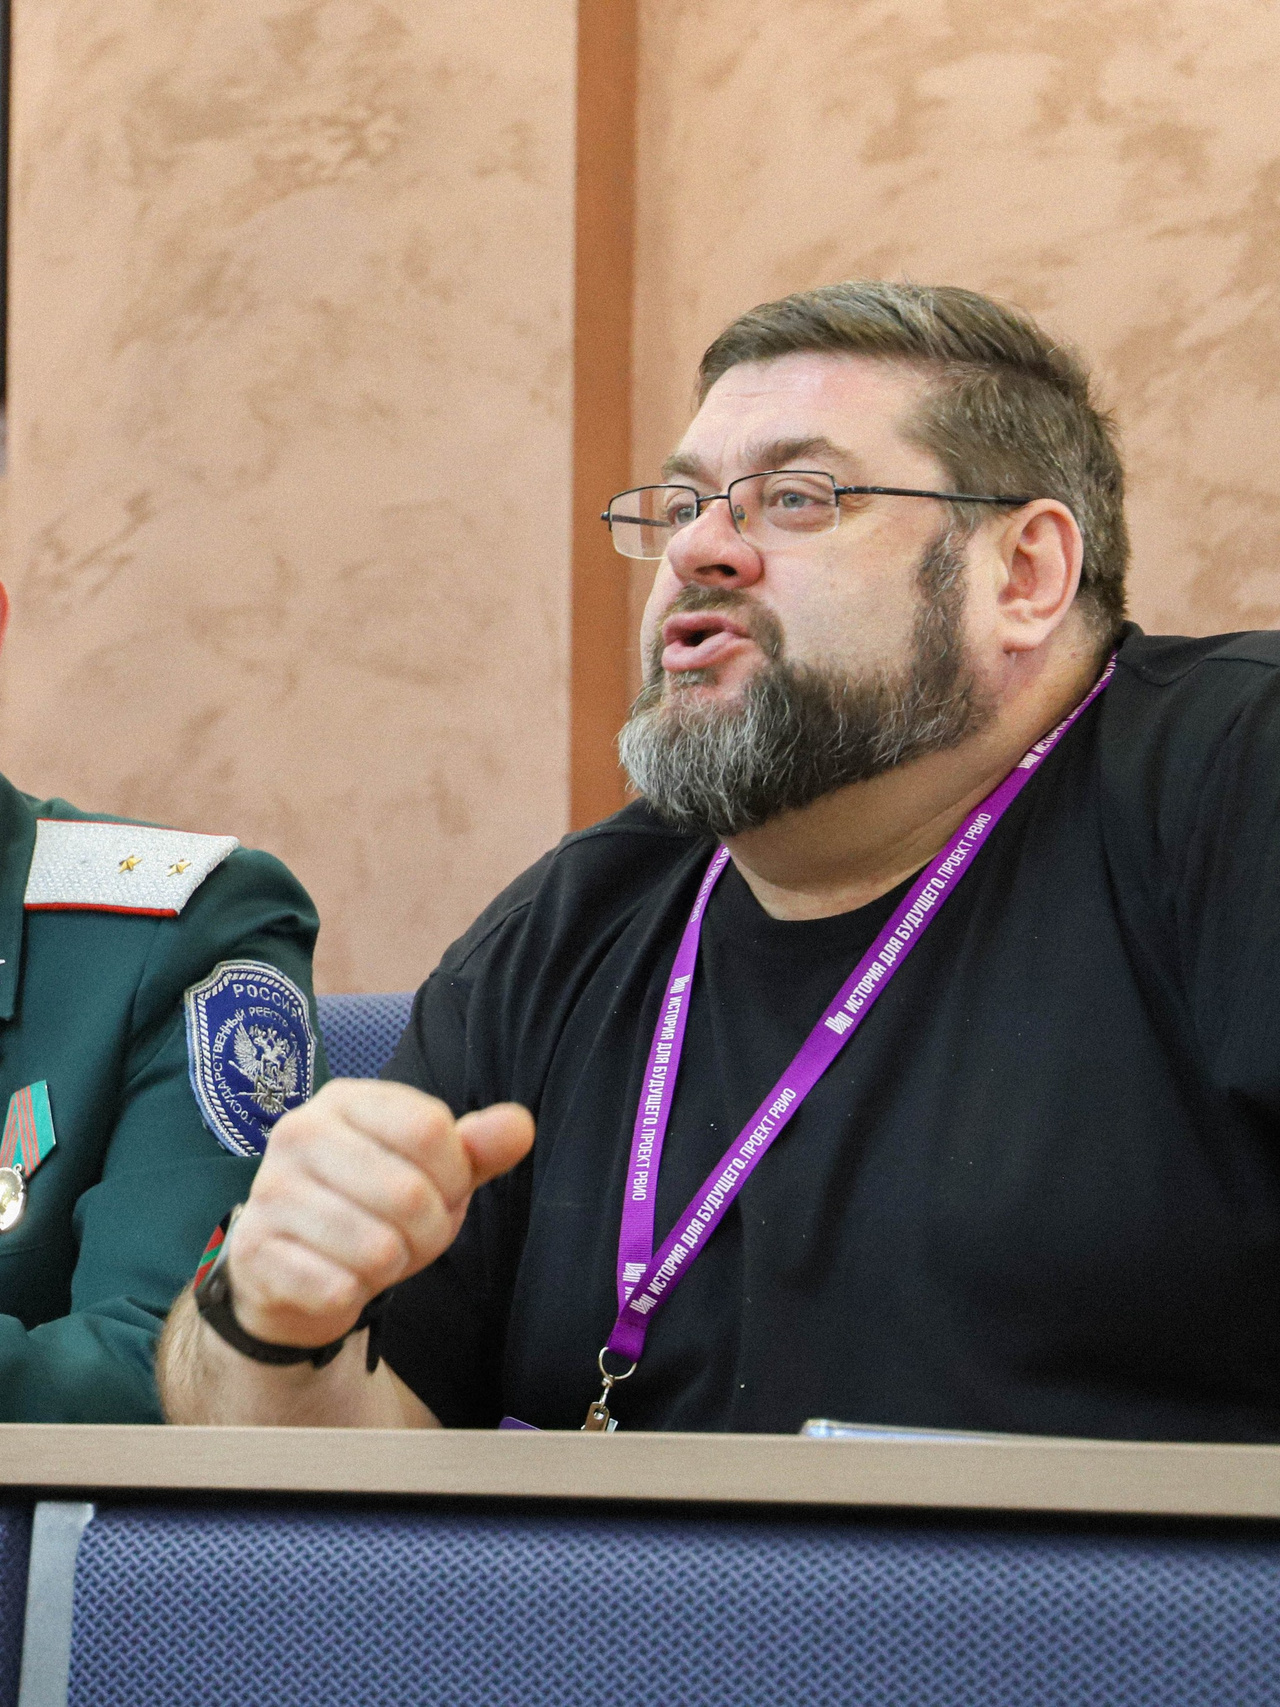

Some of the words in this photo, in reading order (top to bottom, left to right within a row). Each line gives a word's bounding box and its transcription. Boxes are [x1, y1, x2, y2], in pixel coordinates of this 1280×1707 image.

[844, 961, 886, 1014] ИСТОРИЯ
[878, 936, 904, 967] ДЛЯ
[937, 839, 973, 880] ПРОЕКТ
[964, 812, 992, 841] РВИО
[232, 983, 297, 1018] РОССИЯ
[661, 996, 682, 1040] ИСТОРИЯ
[654, 1042, 672, 1064] ДЛЯ
[636, 1128, 657, 1168] ПРОЕКТ
[632, 1171, 648, 1201] РВИО
[647, 1243, 689, 1295] ИСТОРИЯ
[680, 1217, 706, 1249] ДЛЯ
[739, 1115, 776, 1160] ПРОЕКТ
[769, 1087, 797, 1120] РВИО
